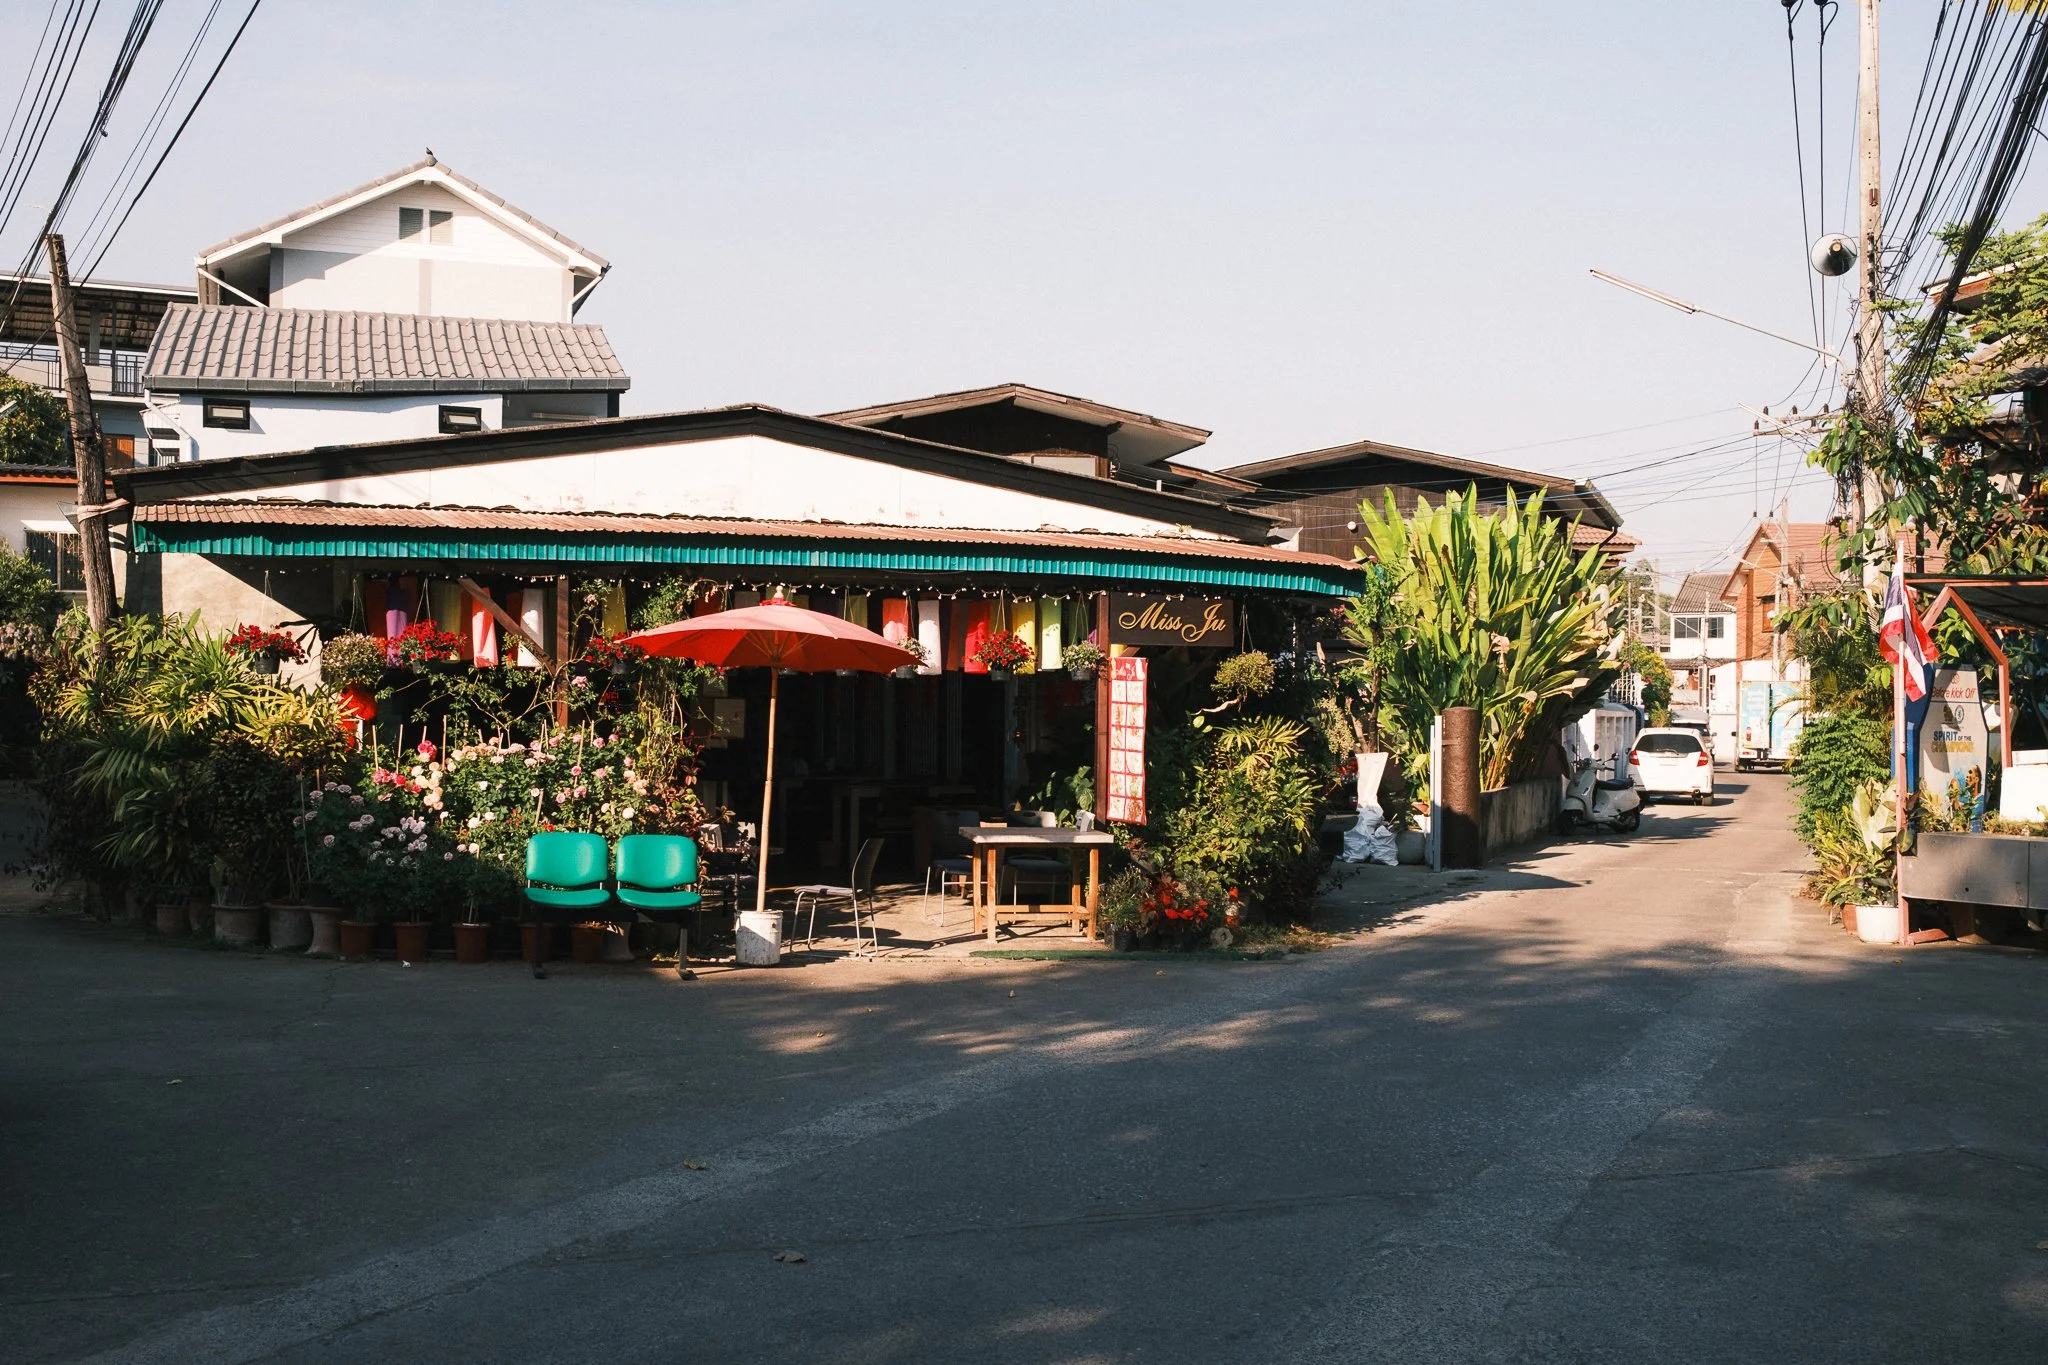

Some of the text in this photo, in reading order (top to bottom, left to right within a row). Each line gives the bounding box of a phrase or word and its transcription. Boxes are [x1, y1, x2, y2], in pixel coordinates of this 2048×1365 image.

[1118, 601, 1226, 643] Miss Ju
[1933, 731, 1958, 741] SPIRIT
